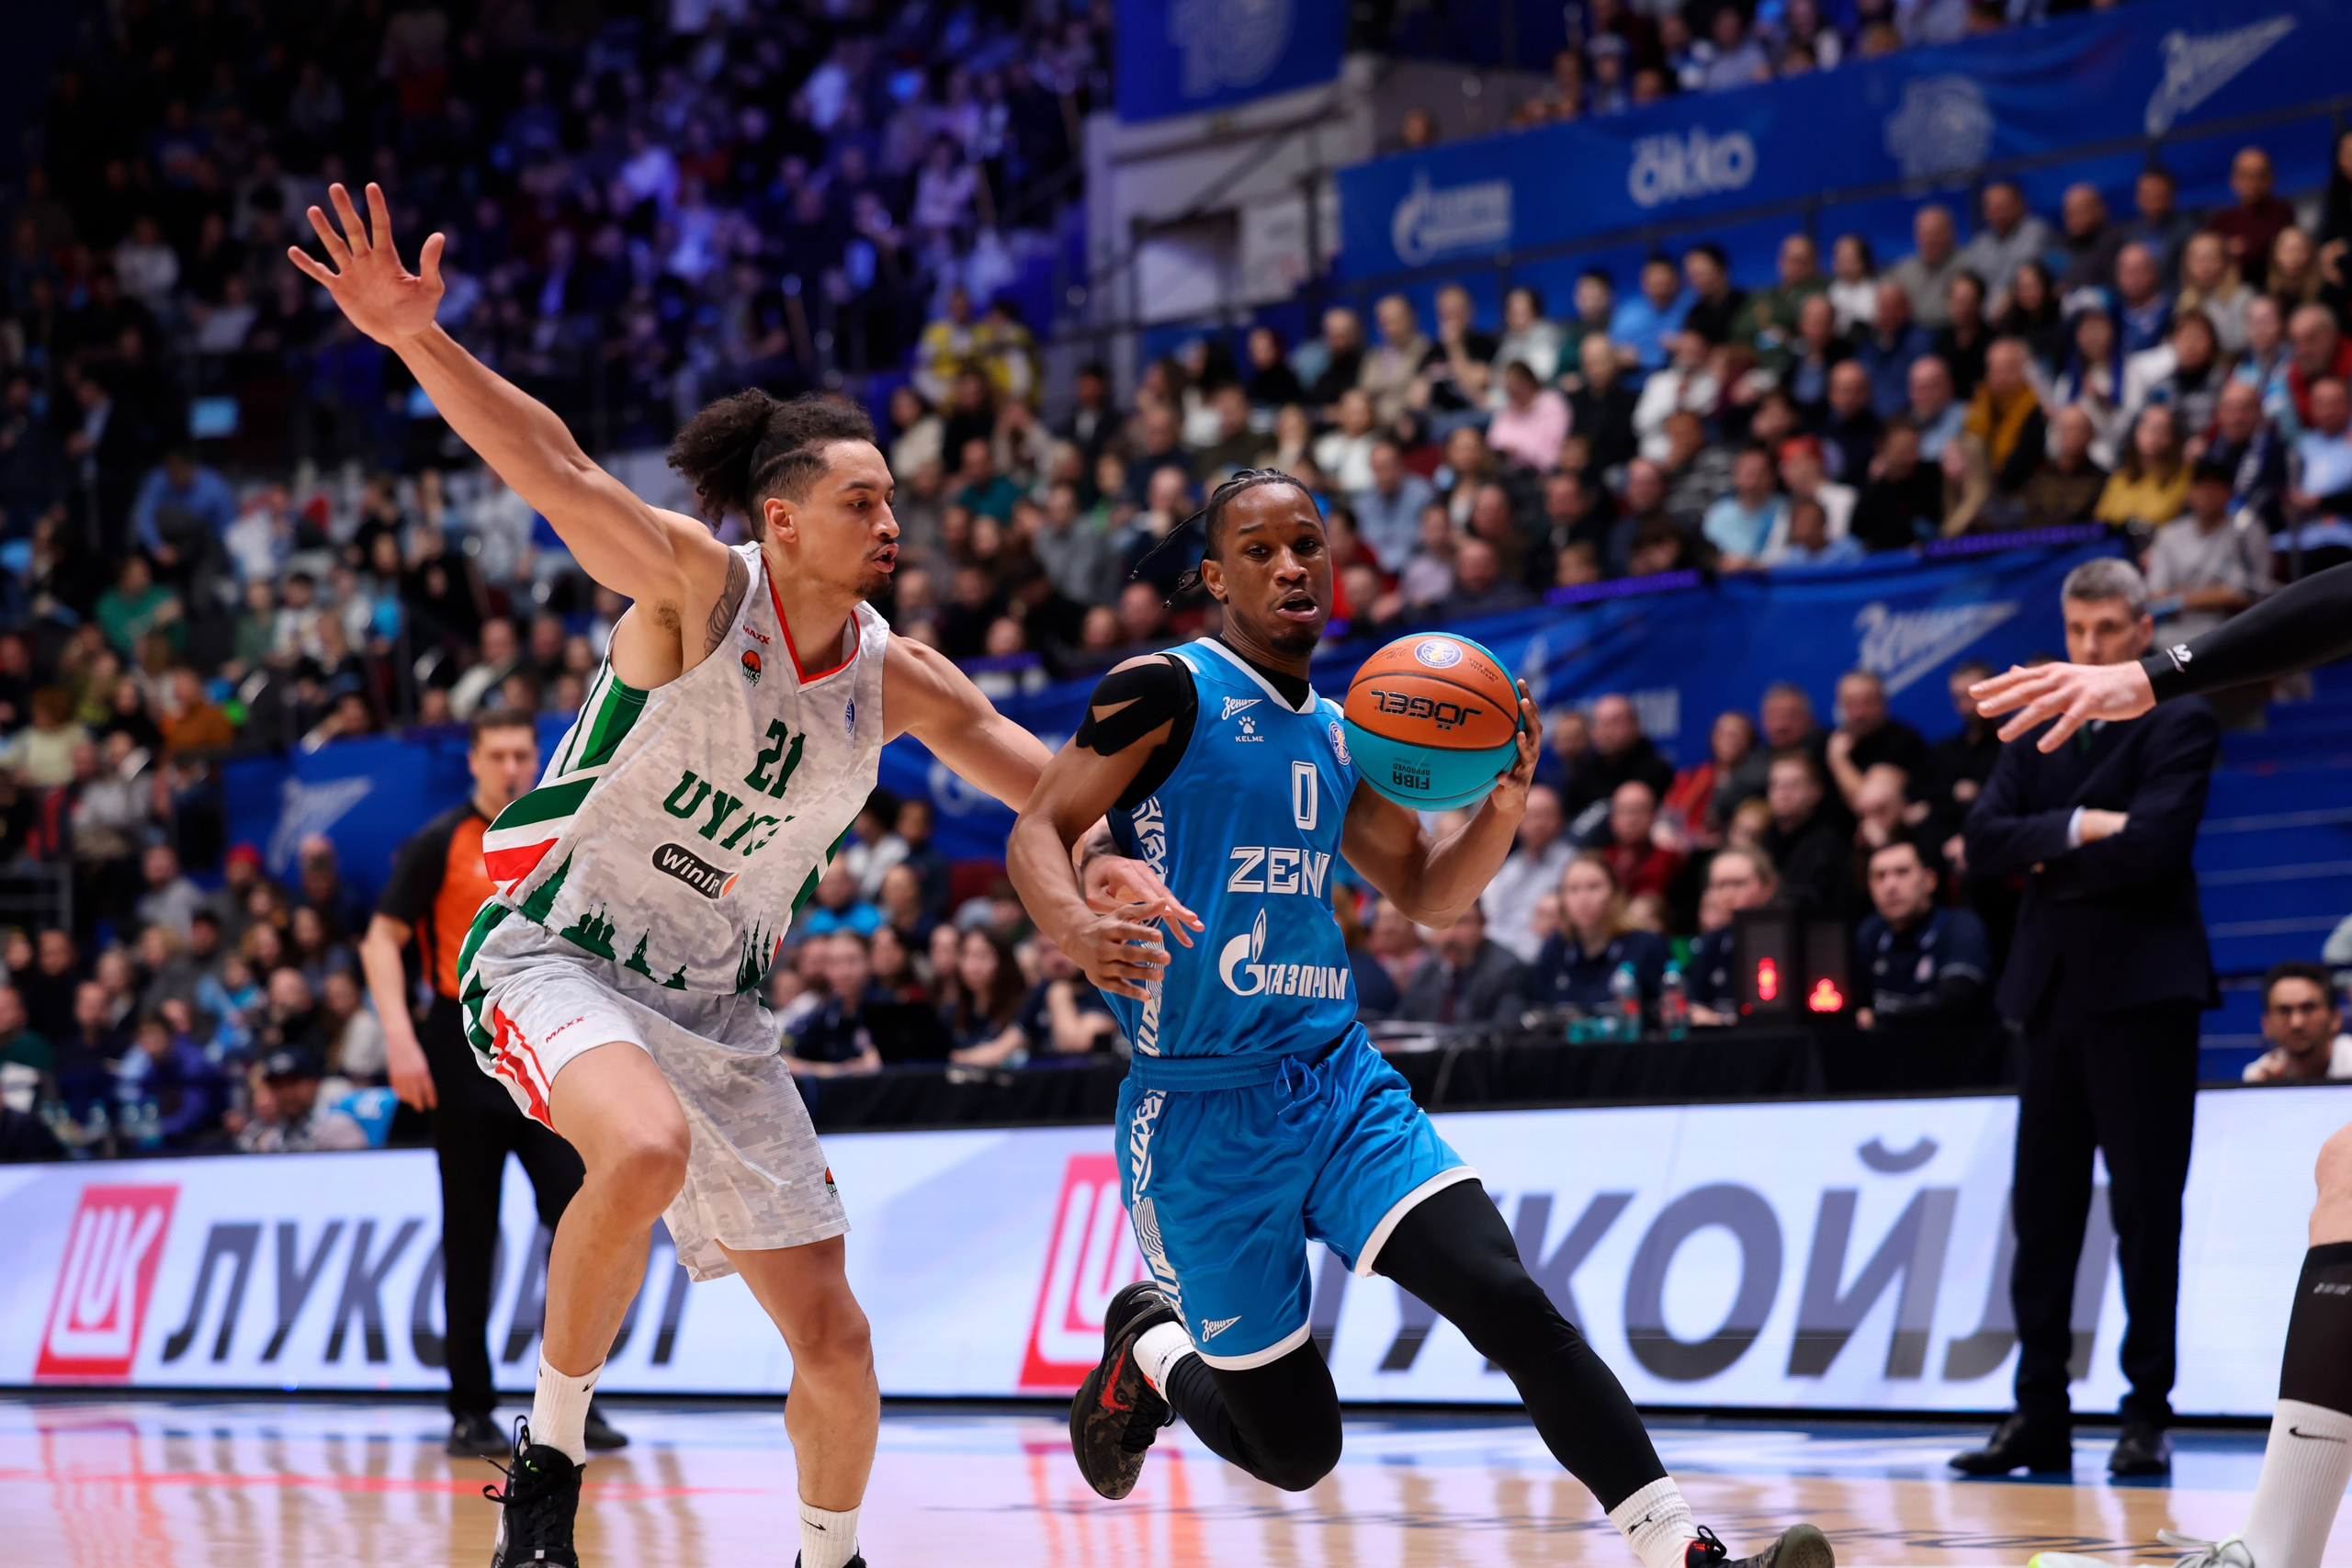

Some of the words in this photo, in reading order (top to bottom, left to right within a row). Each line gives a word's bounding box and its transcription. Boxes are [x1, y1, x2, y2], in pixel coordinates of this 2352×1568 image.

[742, 625, 770, 645] MAXX
[1221, 695, 1263, 721] Зенит
[743, 717, 807, 799] 21
[1392, 761, 1430, 776] APPROVED
[1392, 771, 1430, 790] FIBA
[1292, 760, 1317, 831] 0
[545, 1015, 585, 1044] MAXX
[1201, 1314, 1242, 1344] Зенит
